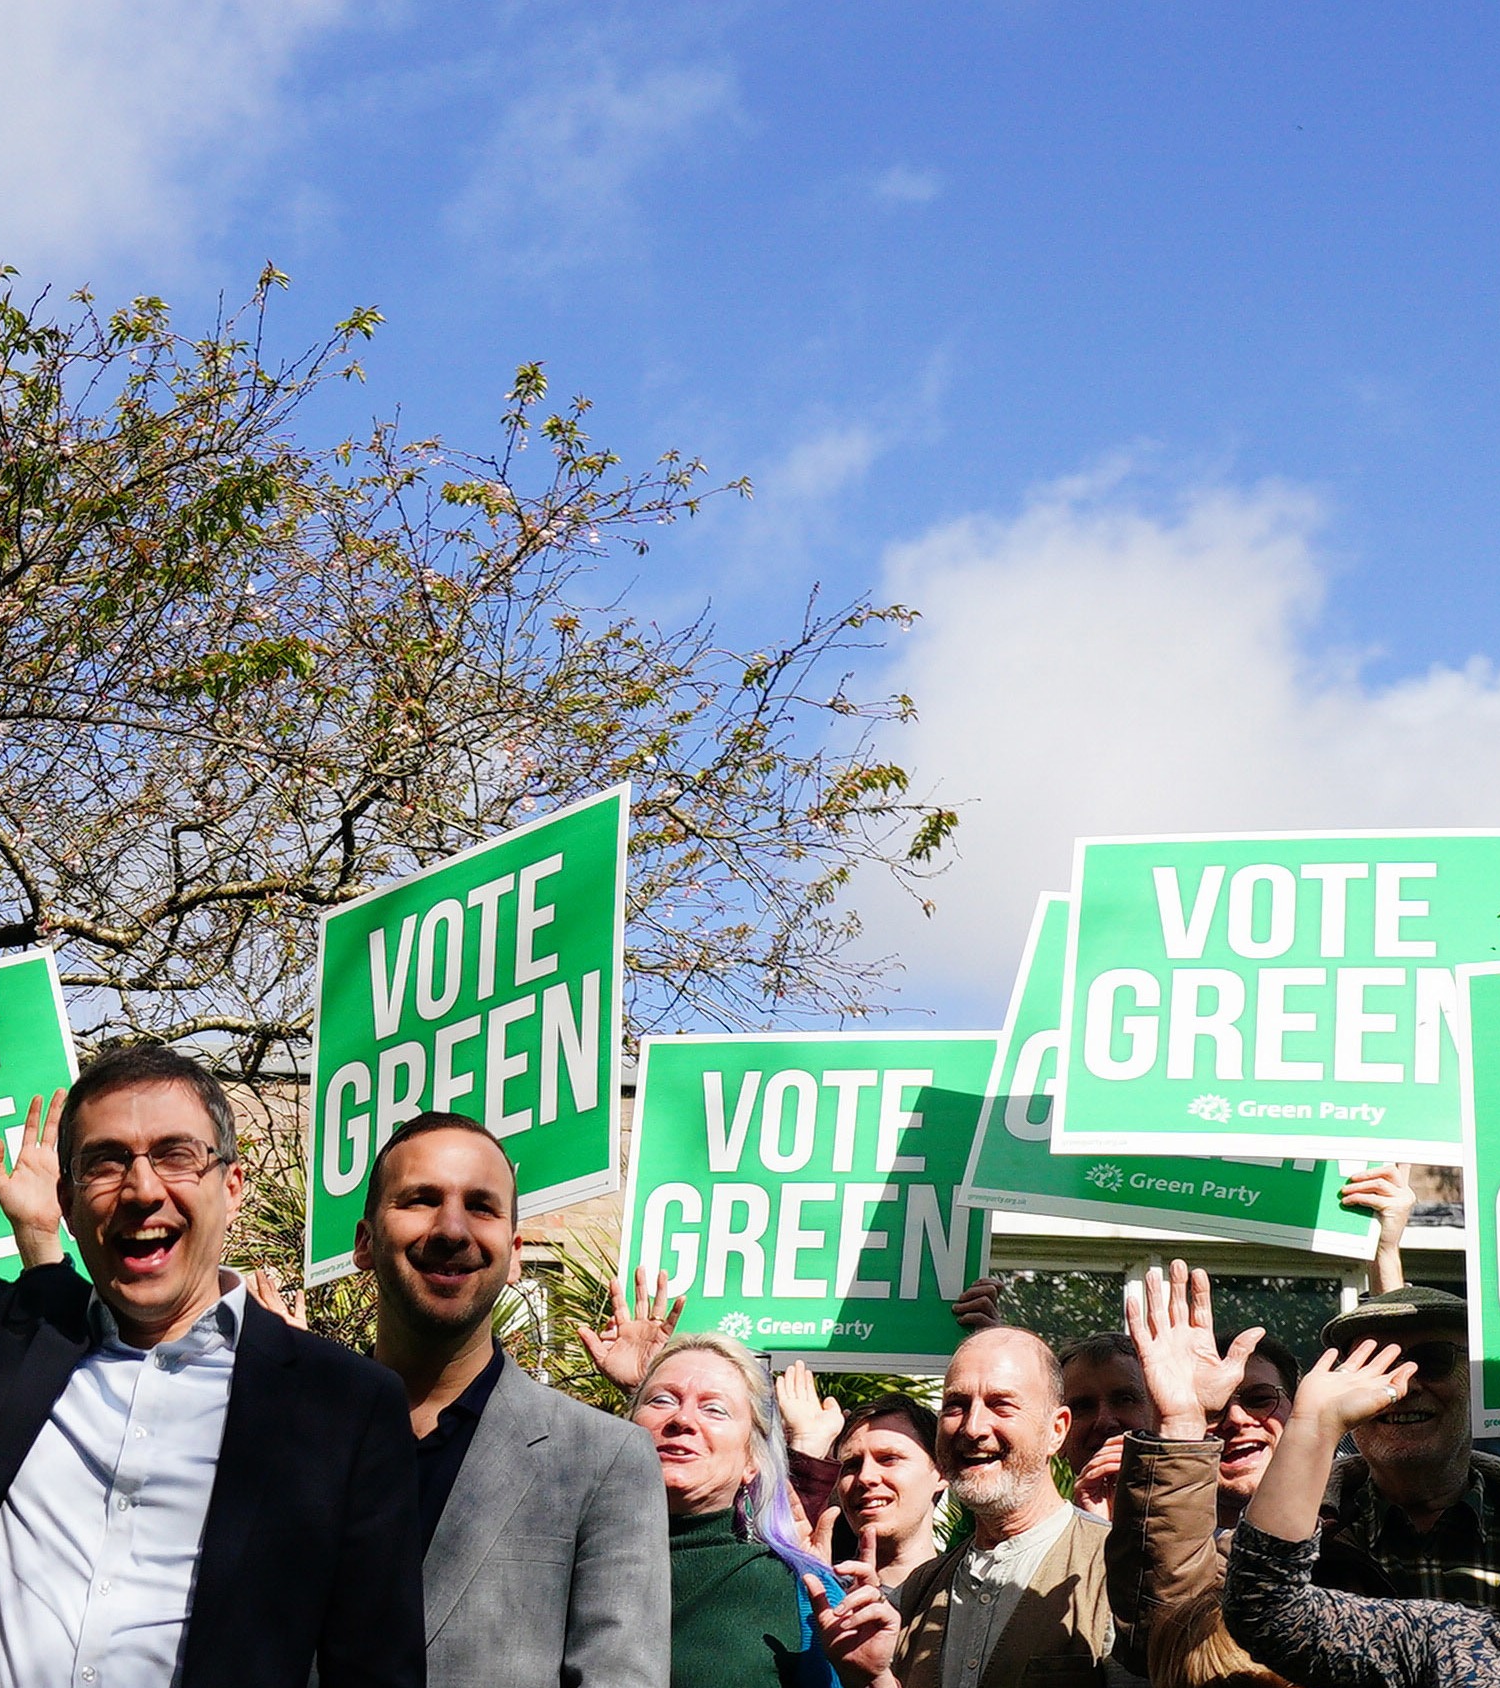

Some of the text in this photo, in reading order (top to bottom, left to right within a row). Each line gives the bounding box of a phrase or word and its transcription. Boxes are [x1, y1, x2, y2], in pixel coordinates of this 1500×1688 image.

[369, 853, 563, 1041] VOTE
[1152, 861, 1438, 959] VOTE
[322, 969, 600, 1197] GREEN
[702, 1069, 933, 1173] VOTE
[1238, 1101, 1386, 1125] Green Party
[639, 1182, 970, 1300] GREEN
[1129, 1173, 1261, 1208] Green Party
[757, 1317, 874, 1340] Green Party
